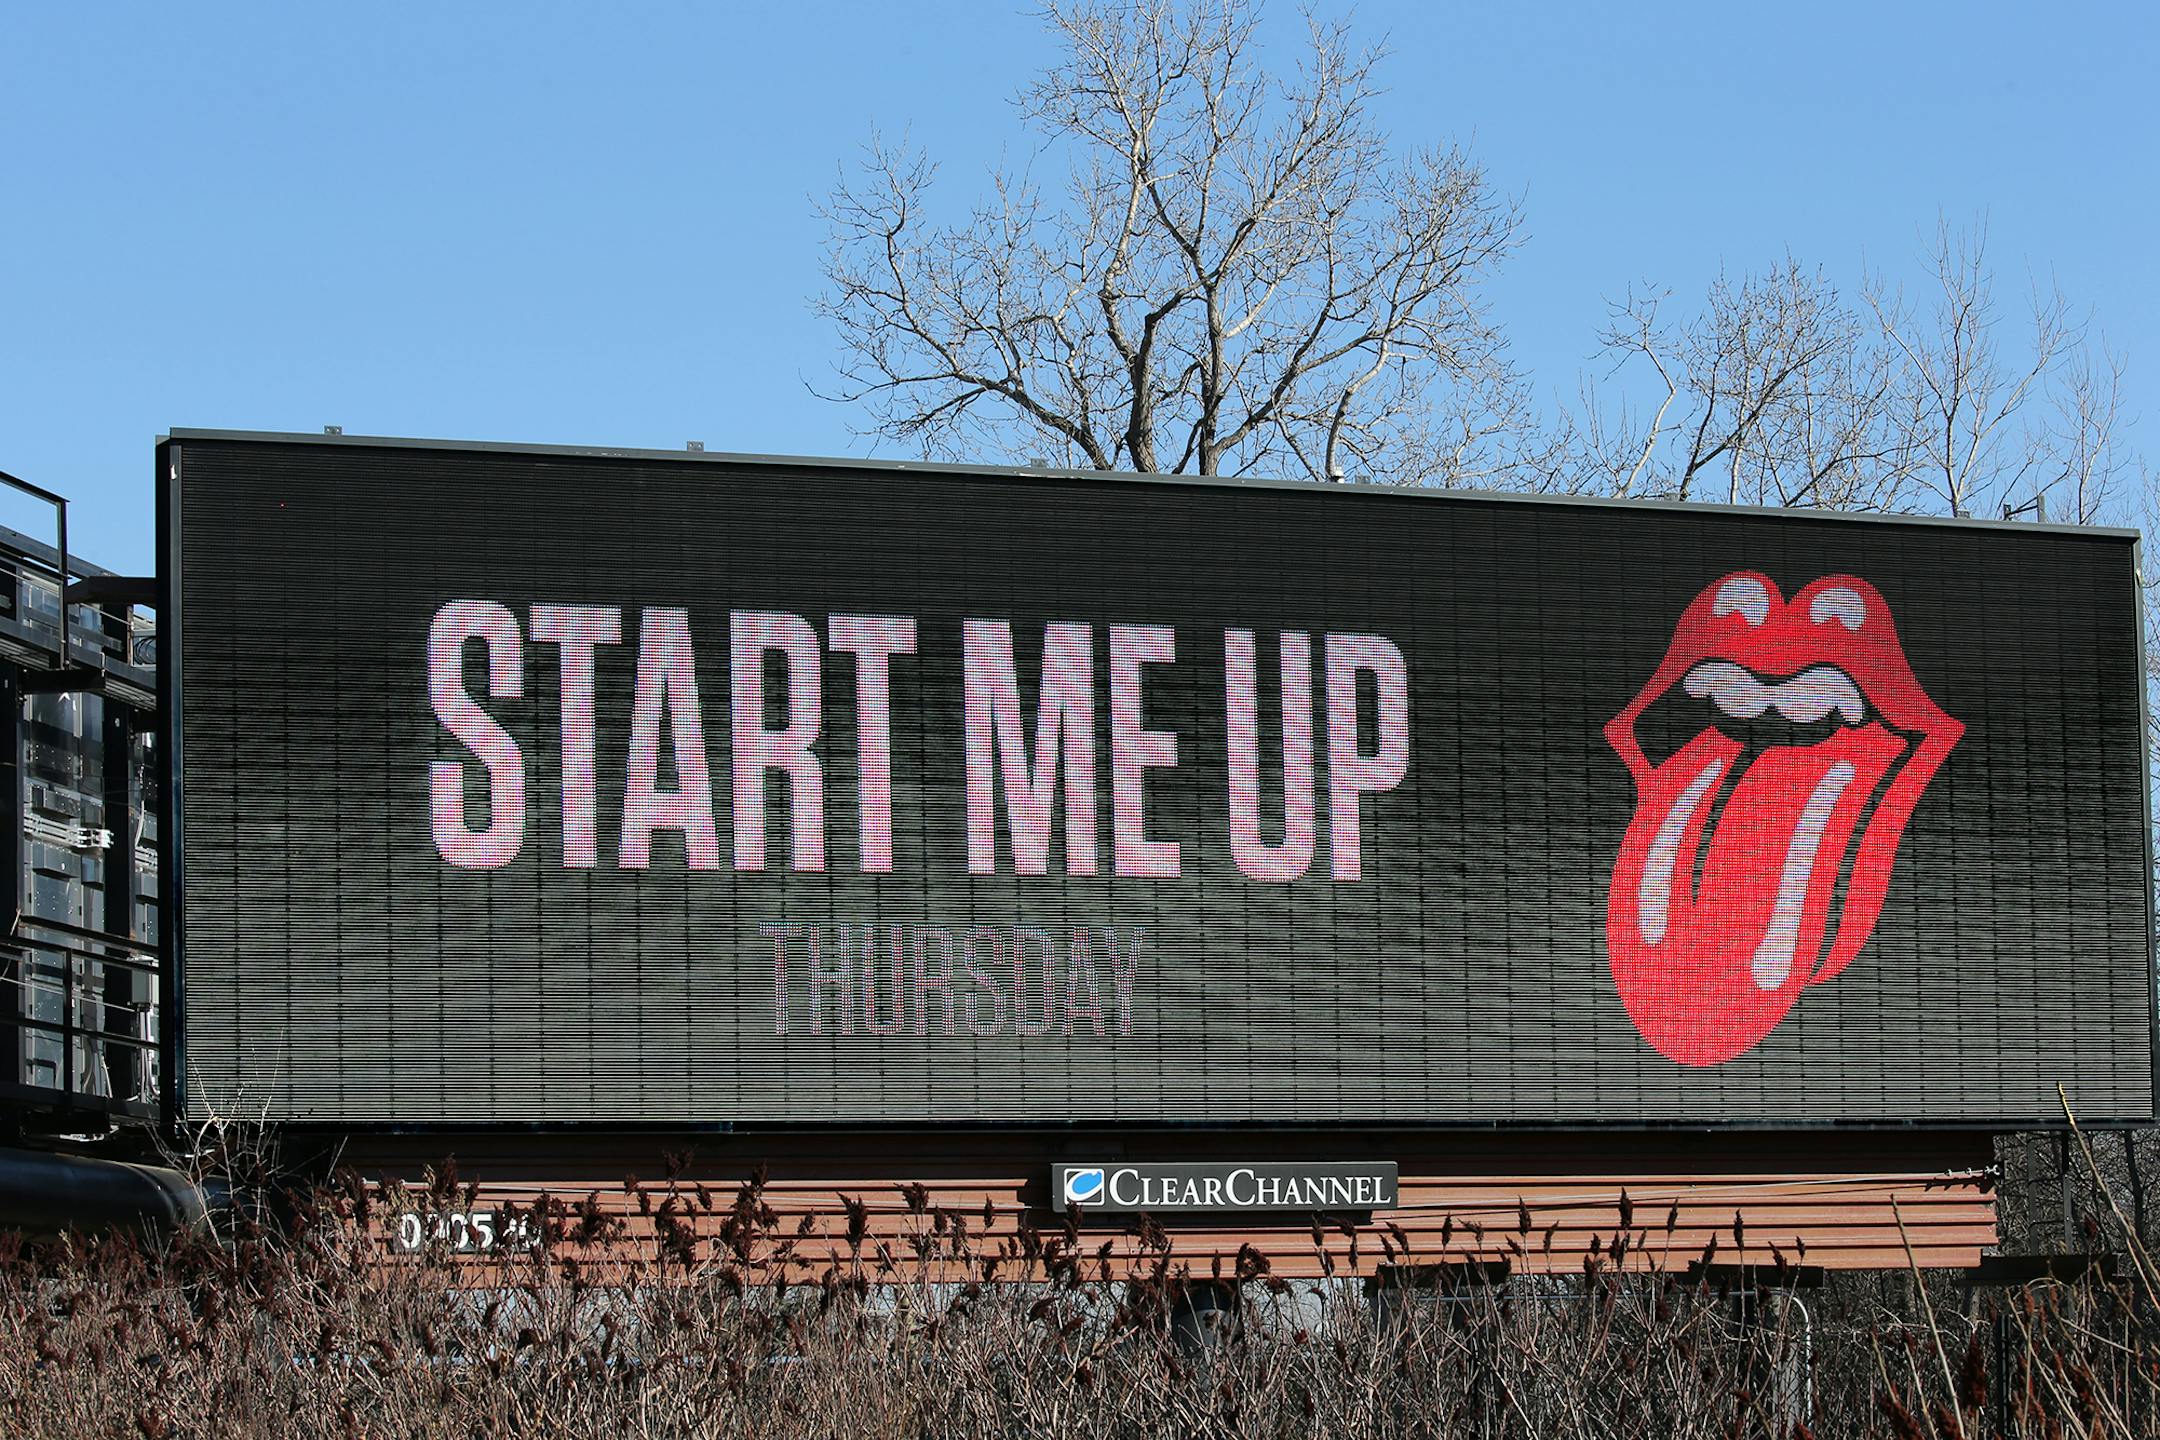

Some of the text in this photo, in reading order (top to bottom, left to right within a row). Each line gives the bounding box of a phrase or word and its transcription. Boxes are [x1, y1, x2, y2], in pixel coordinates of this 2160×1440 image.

[427, 599, 1409, 882] START ME UP
[759, 921, 1146, 1036] THURSDAY
